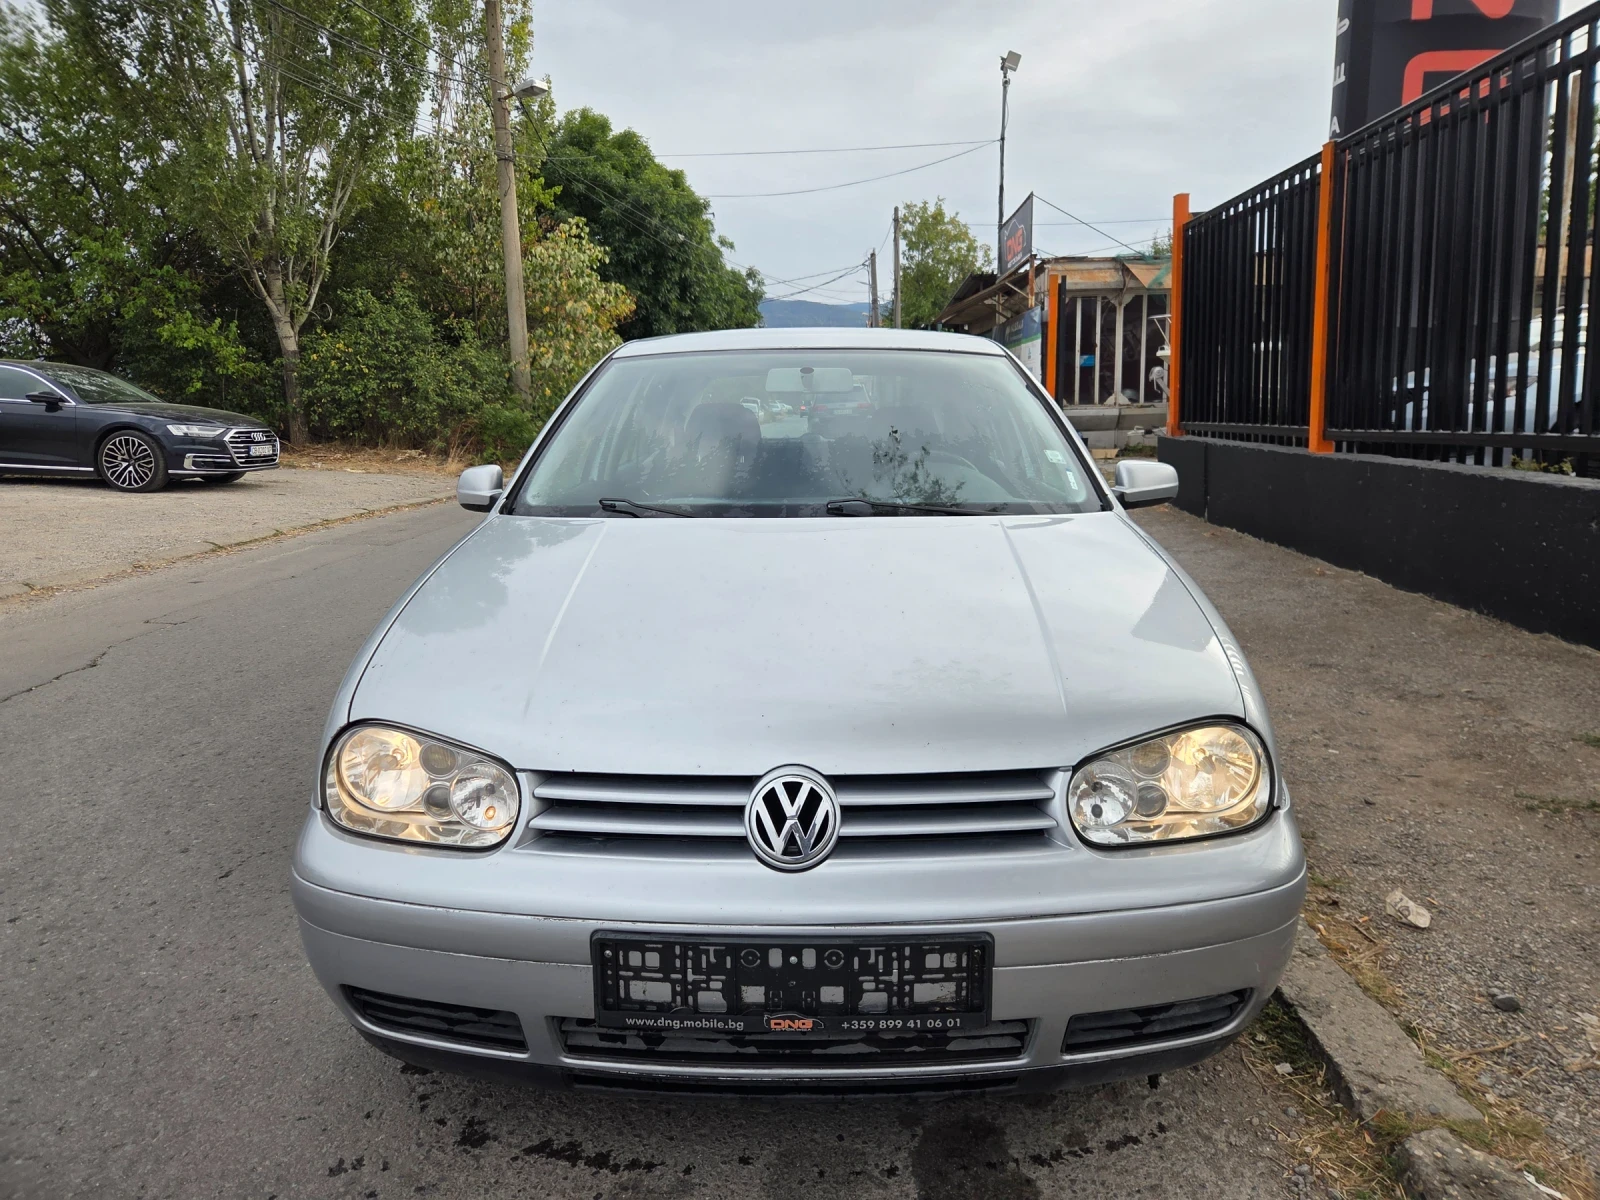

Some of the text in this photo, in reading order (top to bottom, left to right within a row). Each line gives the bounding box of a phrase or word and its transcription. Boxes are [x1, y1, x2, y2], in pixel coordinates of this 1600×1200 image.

[1006, 227, 1023, 262] DNG
[625, 1017, 744, 1031] www.dng.mobile.bg
[770, 1019, 813, 1029] DNG
[841, 1018, 961, 1030] +359 899 41 06 01
